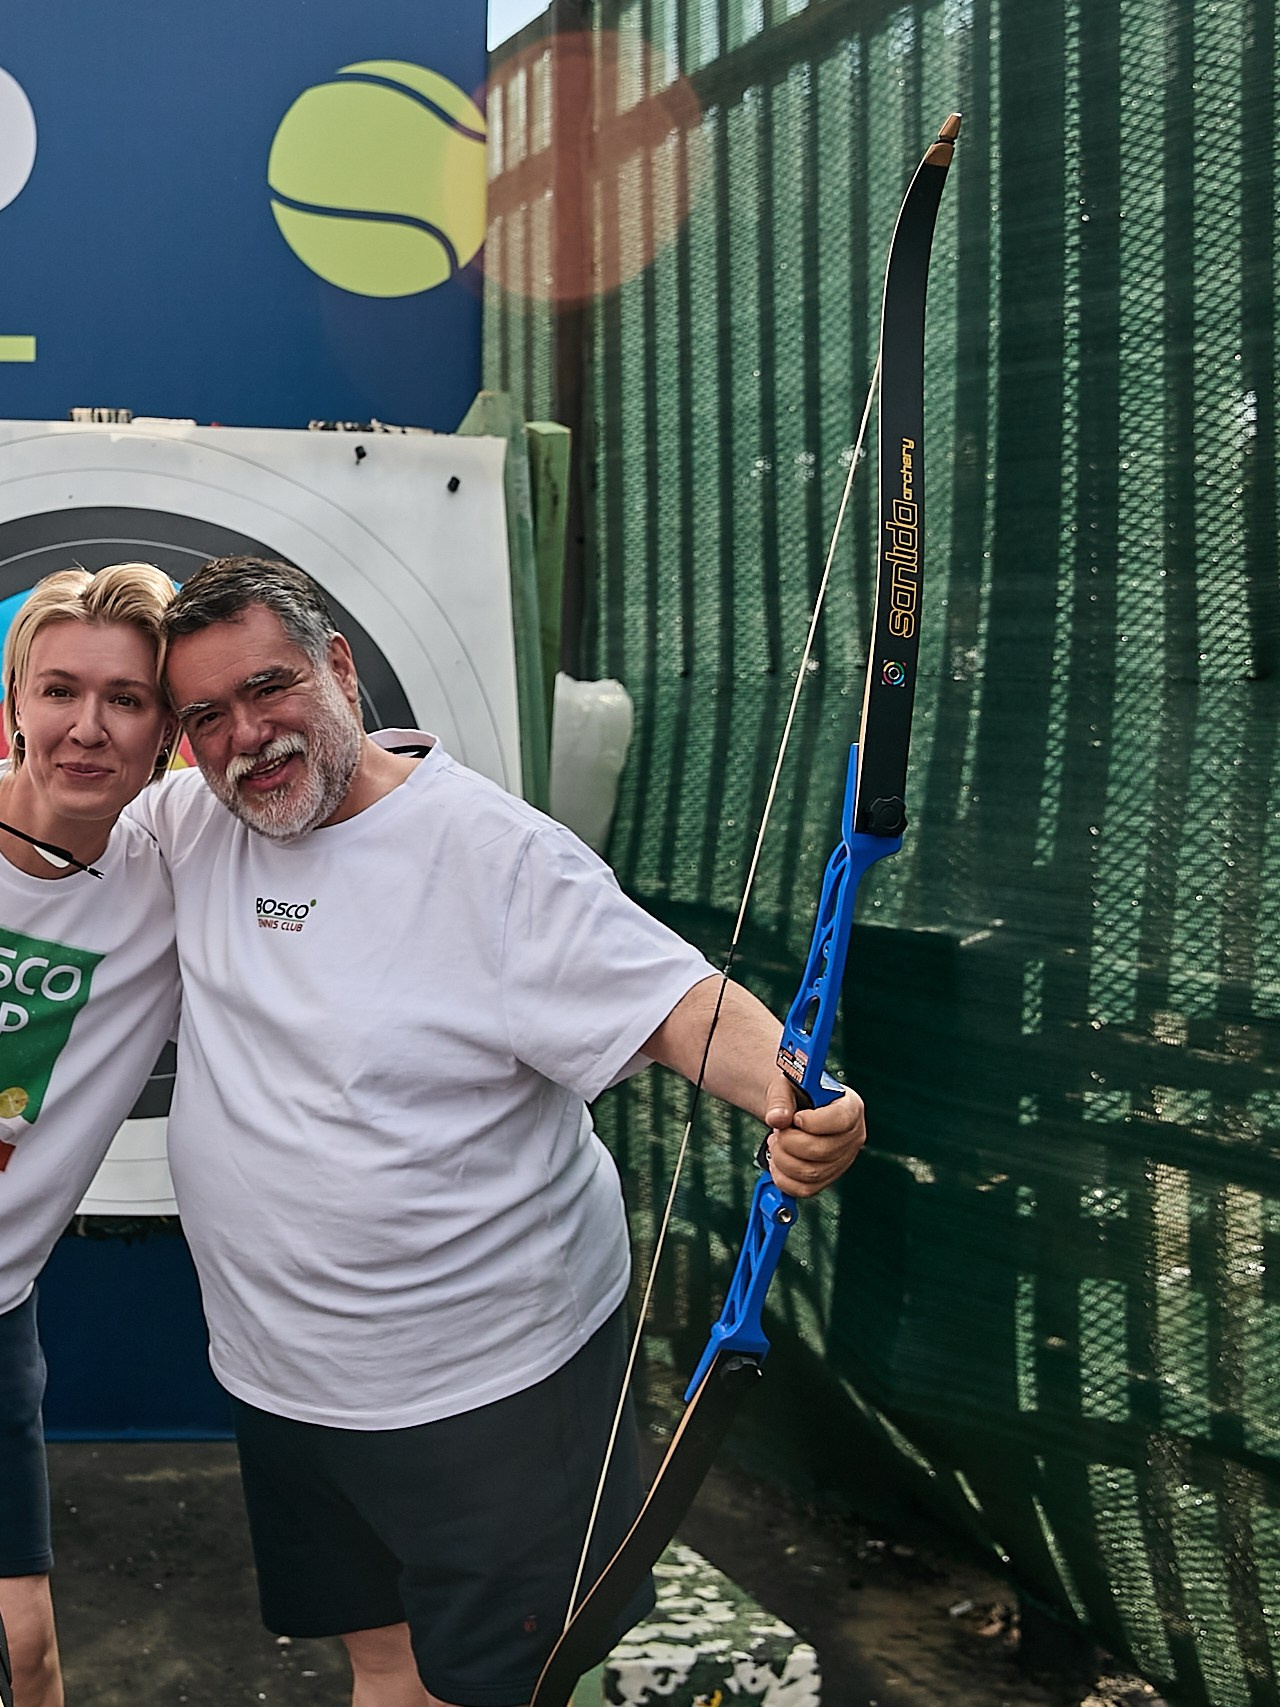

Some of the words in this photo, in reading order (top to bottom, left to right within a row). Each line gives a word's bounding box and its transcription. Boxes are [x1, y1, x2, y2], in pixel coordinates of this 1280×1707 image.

[900, 438, 915, 500] archery
[256, 897, 309, 919] BOSCO
[281, 922, 303, 932] CLUB
